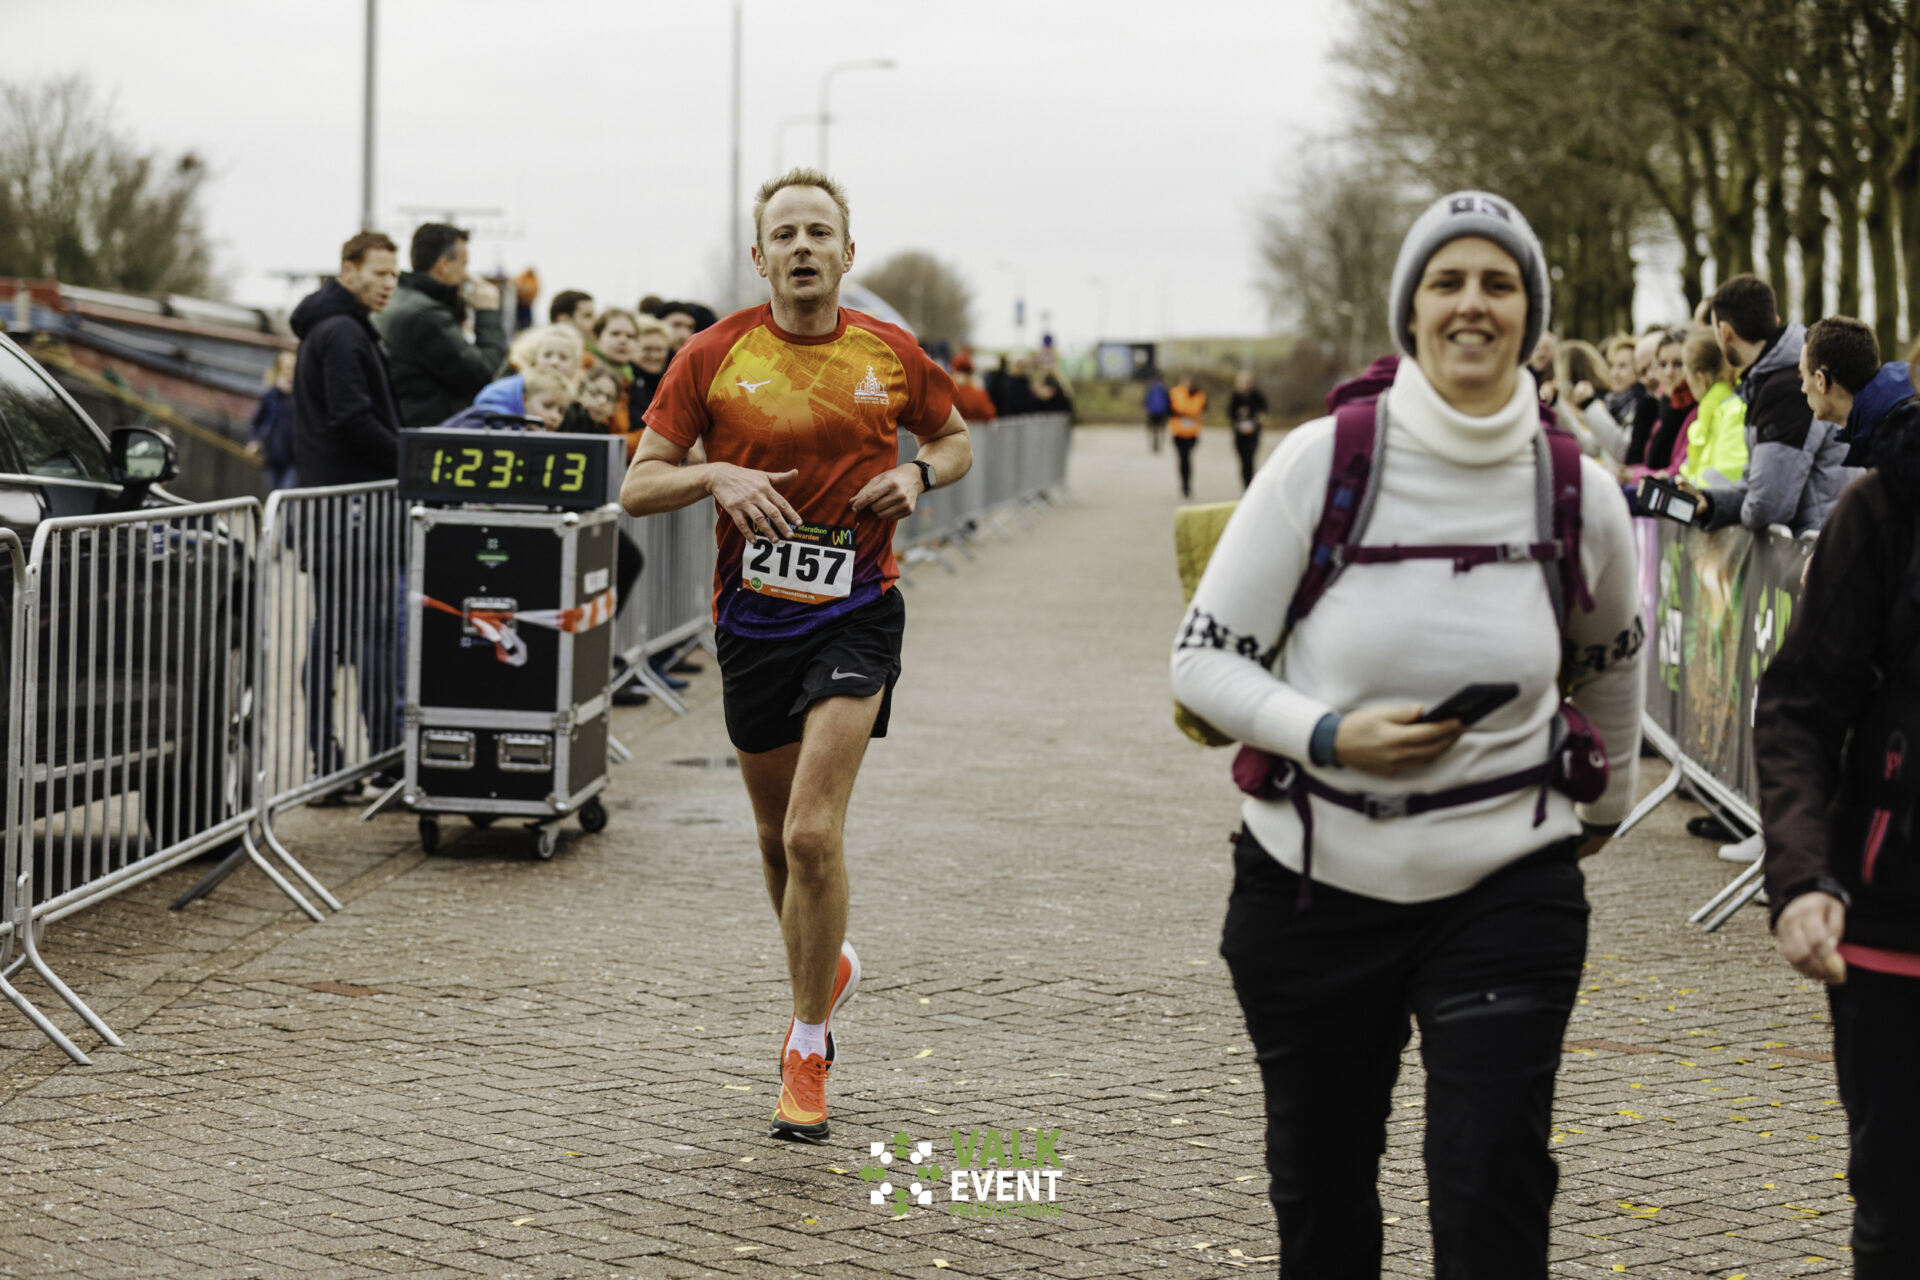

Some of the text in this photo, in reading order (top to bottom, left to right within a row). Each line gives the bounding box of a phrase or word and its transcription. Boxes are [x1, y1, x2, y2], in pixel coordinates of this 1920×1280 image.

[431, 448, 587, 491] 1:23:13
[793, 533, 820, 541] uwarden
[798, 525, 828, 535] Marathon
[750, 539, 847, 585] 2157
